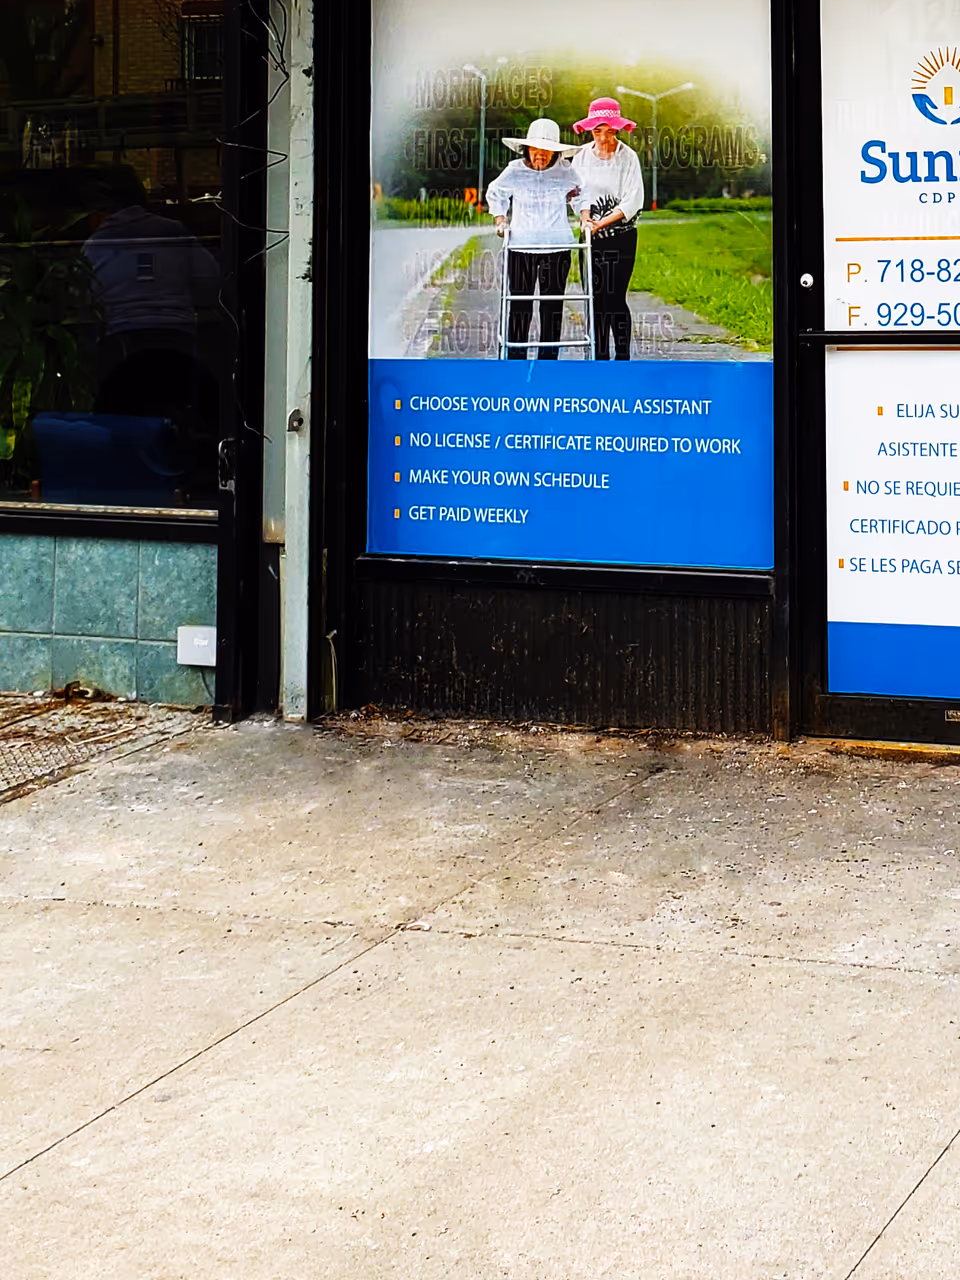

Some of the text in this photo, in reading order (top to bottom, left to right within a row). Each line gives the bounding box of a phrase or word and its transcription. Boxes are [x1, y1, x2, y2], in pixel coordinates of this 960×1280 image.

[410, 396, 712, 414] CHOOSE YOUR OWN PERSONAL ASSISTANT
[897, 404, 935, 418] ELIJA
[940, 404, 959, 418] SU
[411, 433, 740, 453] NO LICENSE / CERTIFICATE REQUIRED TO WORK
[878, 442, 957, 457] ASISTENTE
[410, 470, 609, 488] MAKE YOUR OWN SCHEDULE
[857, 481, 879, 494] NO
[885, 481, 901, 495] SE
[409, 506, 528, 523] GET PAID WEEKLY
[850, 519, 951, 535] CERTIFICADO
[850, 558, 866, 572] SE
[872, 558, 896, 572] LES
[902, 559, 942, 574] PAGA
